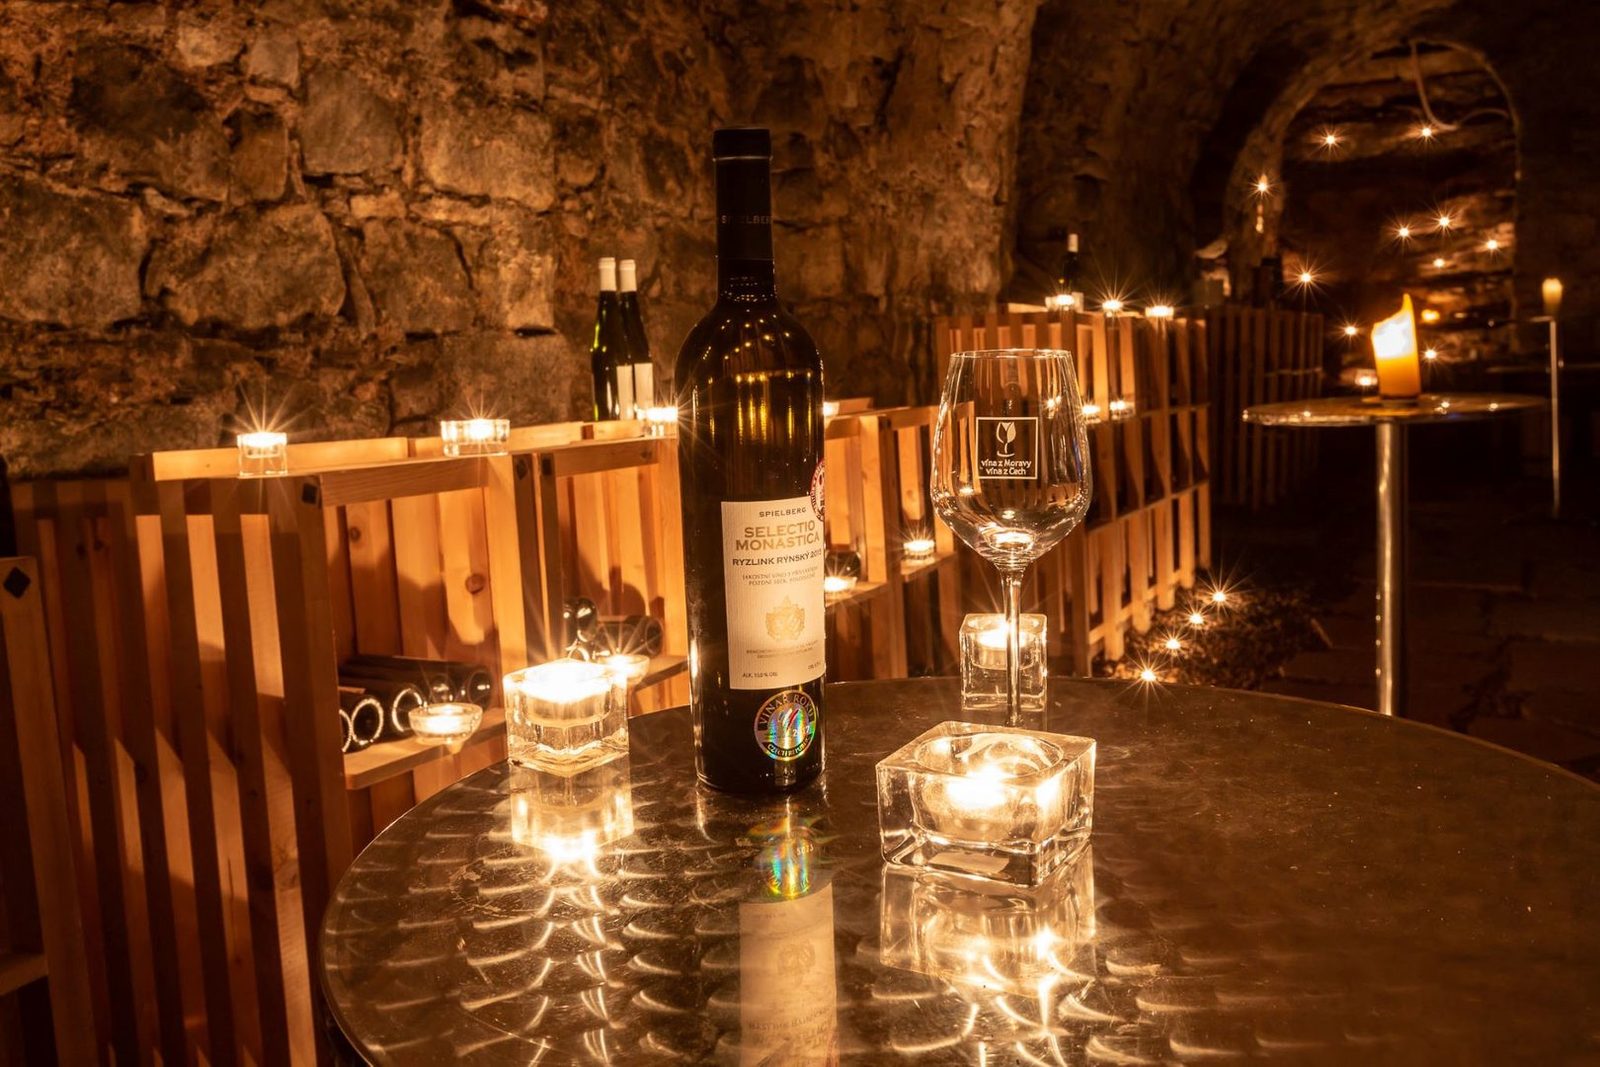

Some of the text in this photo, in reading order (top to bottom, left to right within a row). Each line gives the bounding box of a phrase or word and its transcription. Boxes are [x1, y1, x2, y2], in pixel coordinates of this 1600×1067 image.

[1004, 459, 1032, 468] Moravy
[759, 506, 807, 518] SPIELBERG
[744, 520, 816, 538] SELECTIO
[735, 531, 820, 551] MONASTICA
[732, 558, 775, 566] RYZLINK
[793, 694, 814, 718] ROKU
